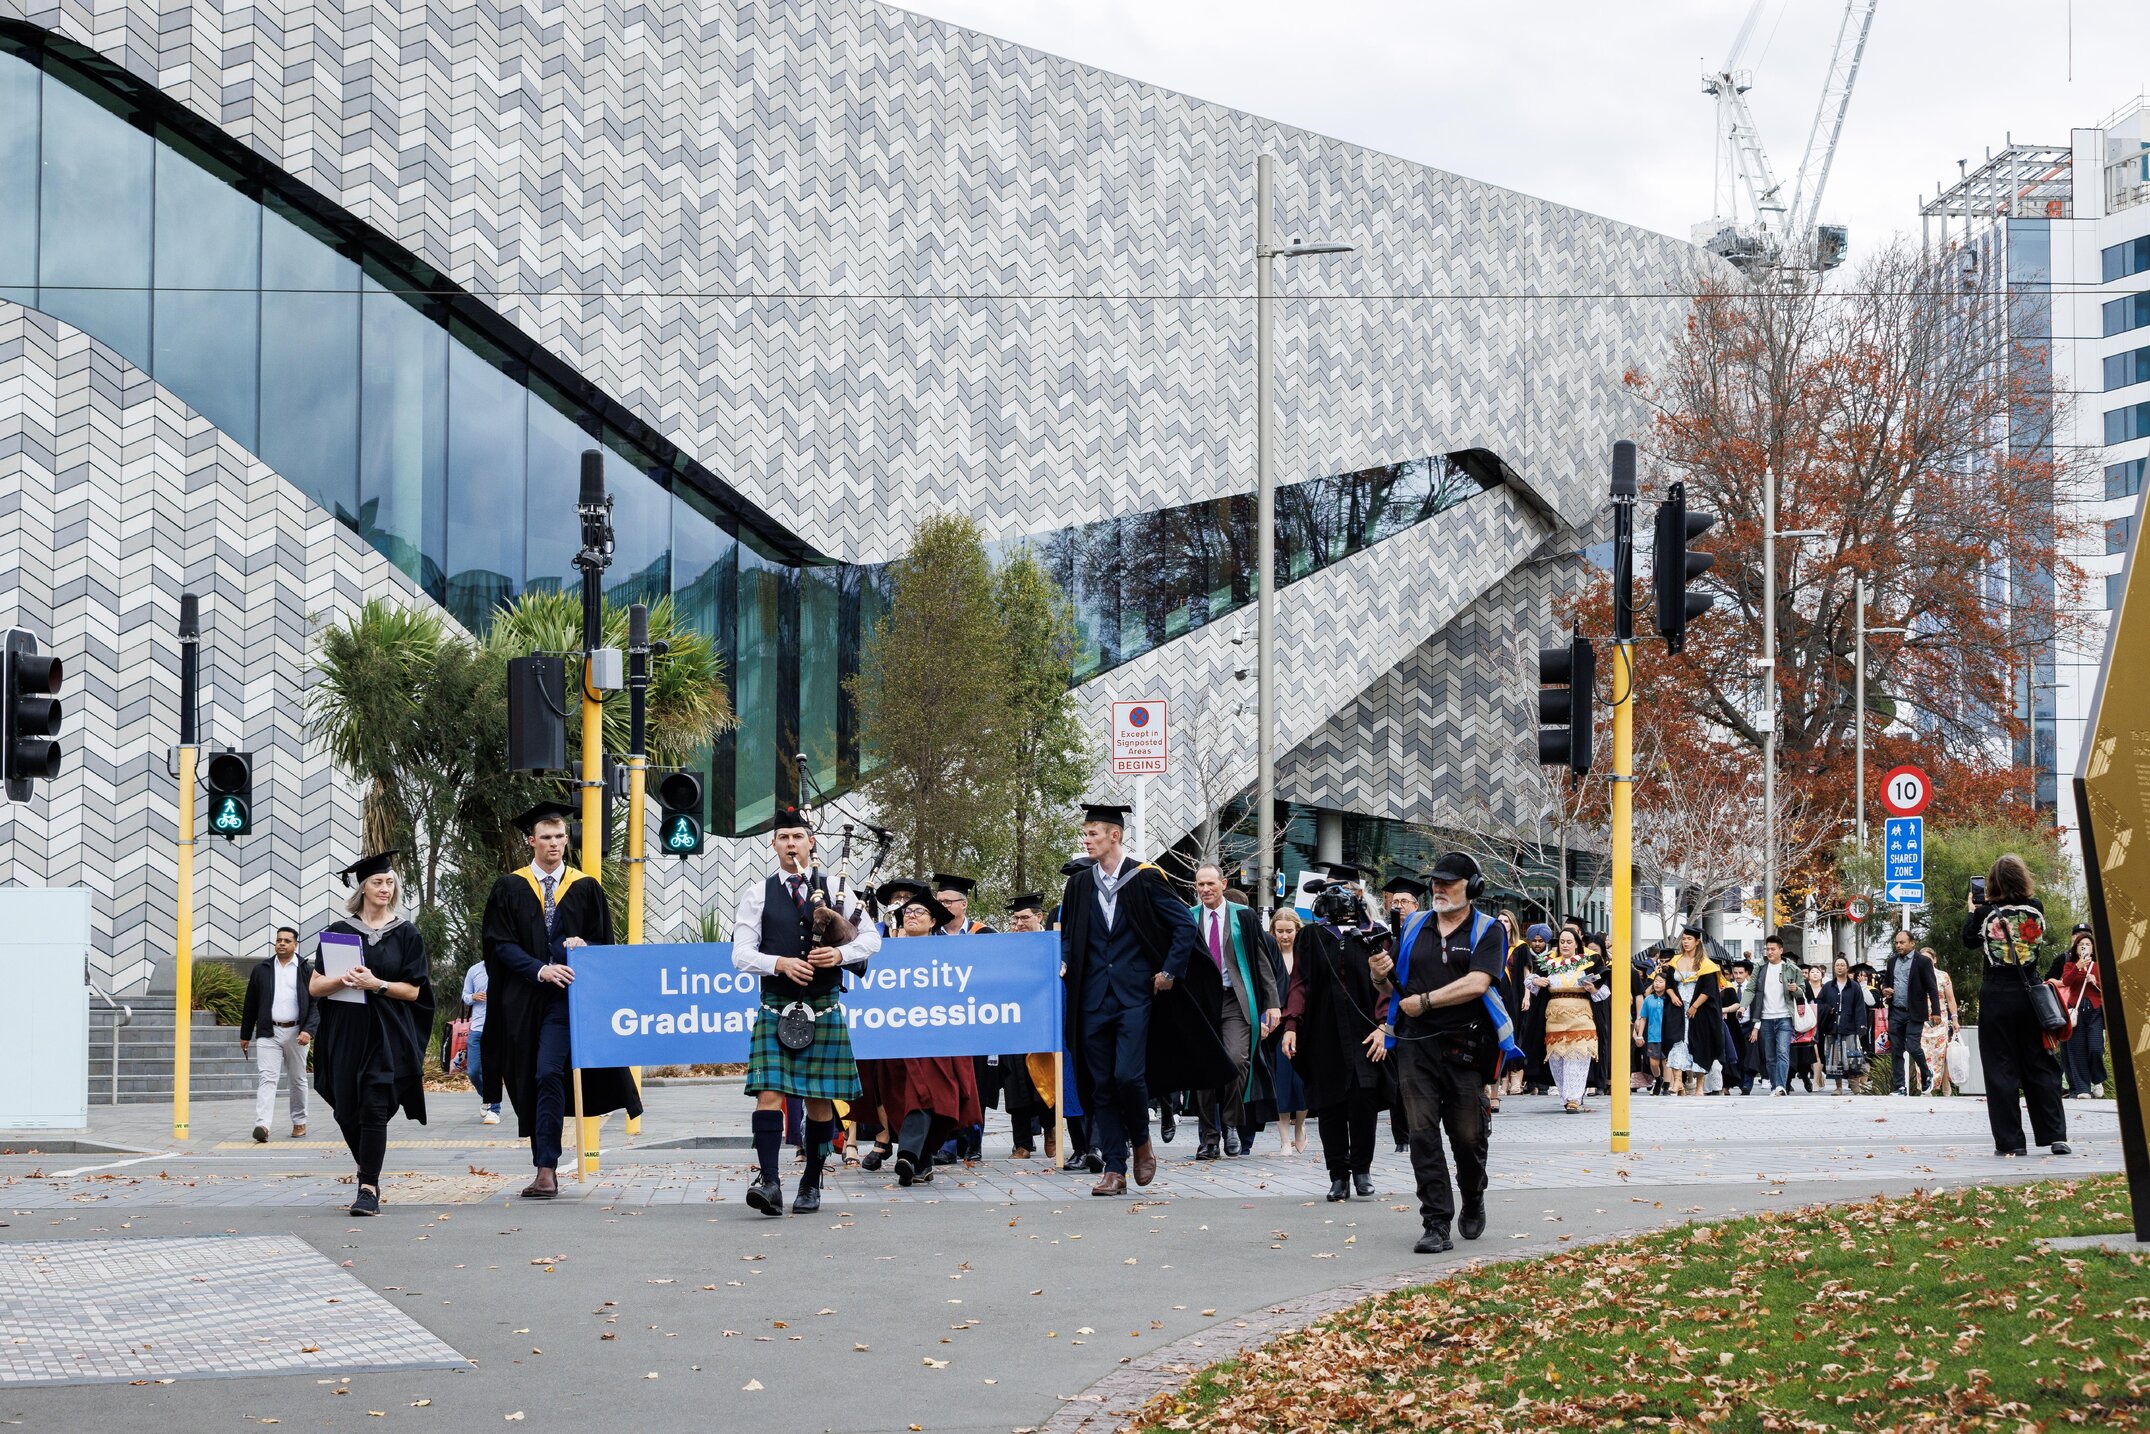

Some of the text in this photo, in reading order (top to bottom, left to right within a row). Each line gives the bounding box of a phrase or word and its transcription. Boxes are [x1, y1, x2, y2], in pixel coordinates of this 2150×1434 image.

[1121, 730, 1149, 738] Except
[1116, 738, 1163, 748] Signposted
[1118, 760, 1161, 770] BEGINS
[1896, 781, 1917, 800] 10
[1890, 853, 1918, 864] SHARED
[1894, 866, 1914, 877] ZONE
[660, 959, 974, 995] Linco iversity
[611, 1004, 758, 1036] Graduat
